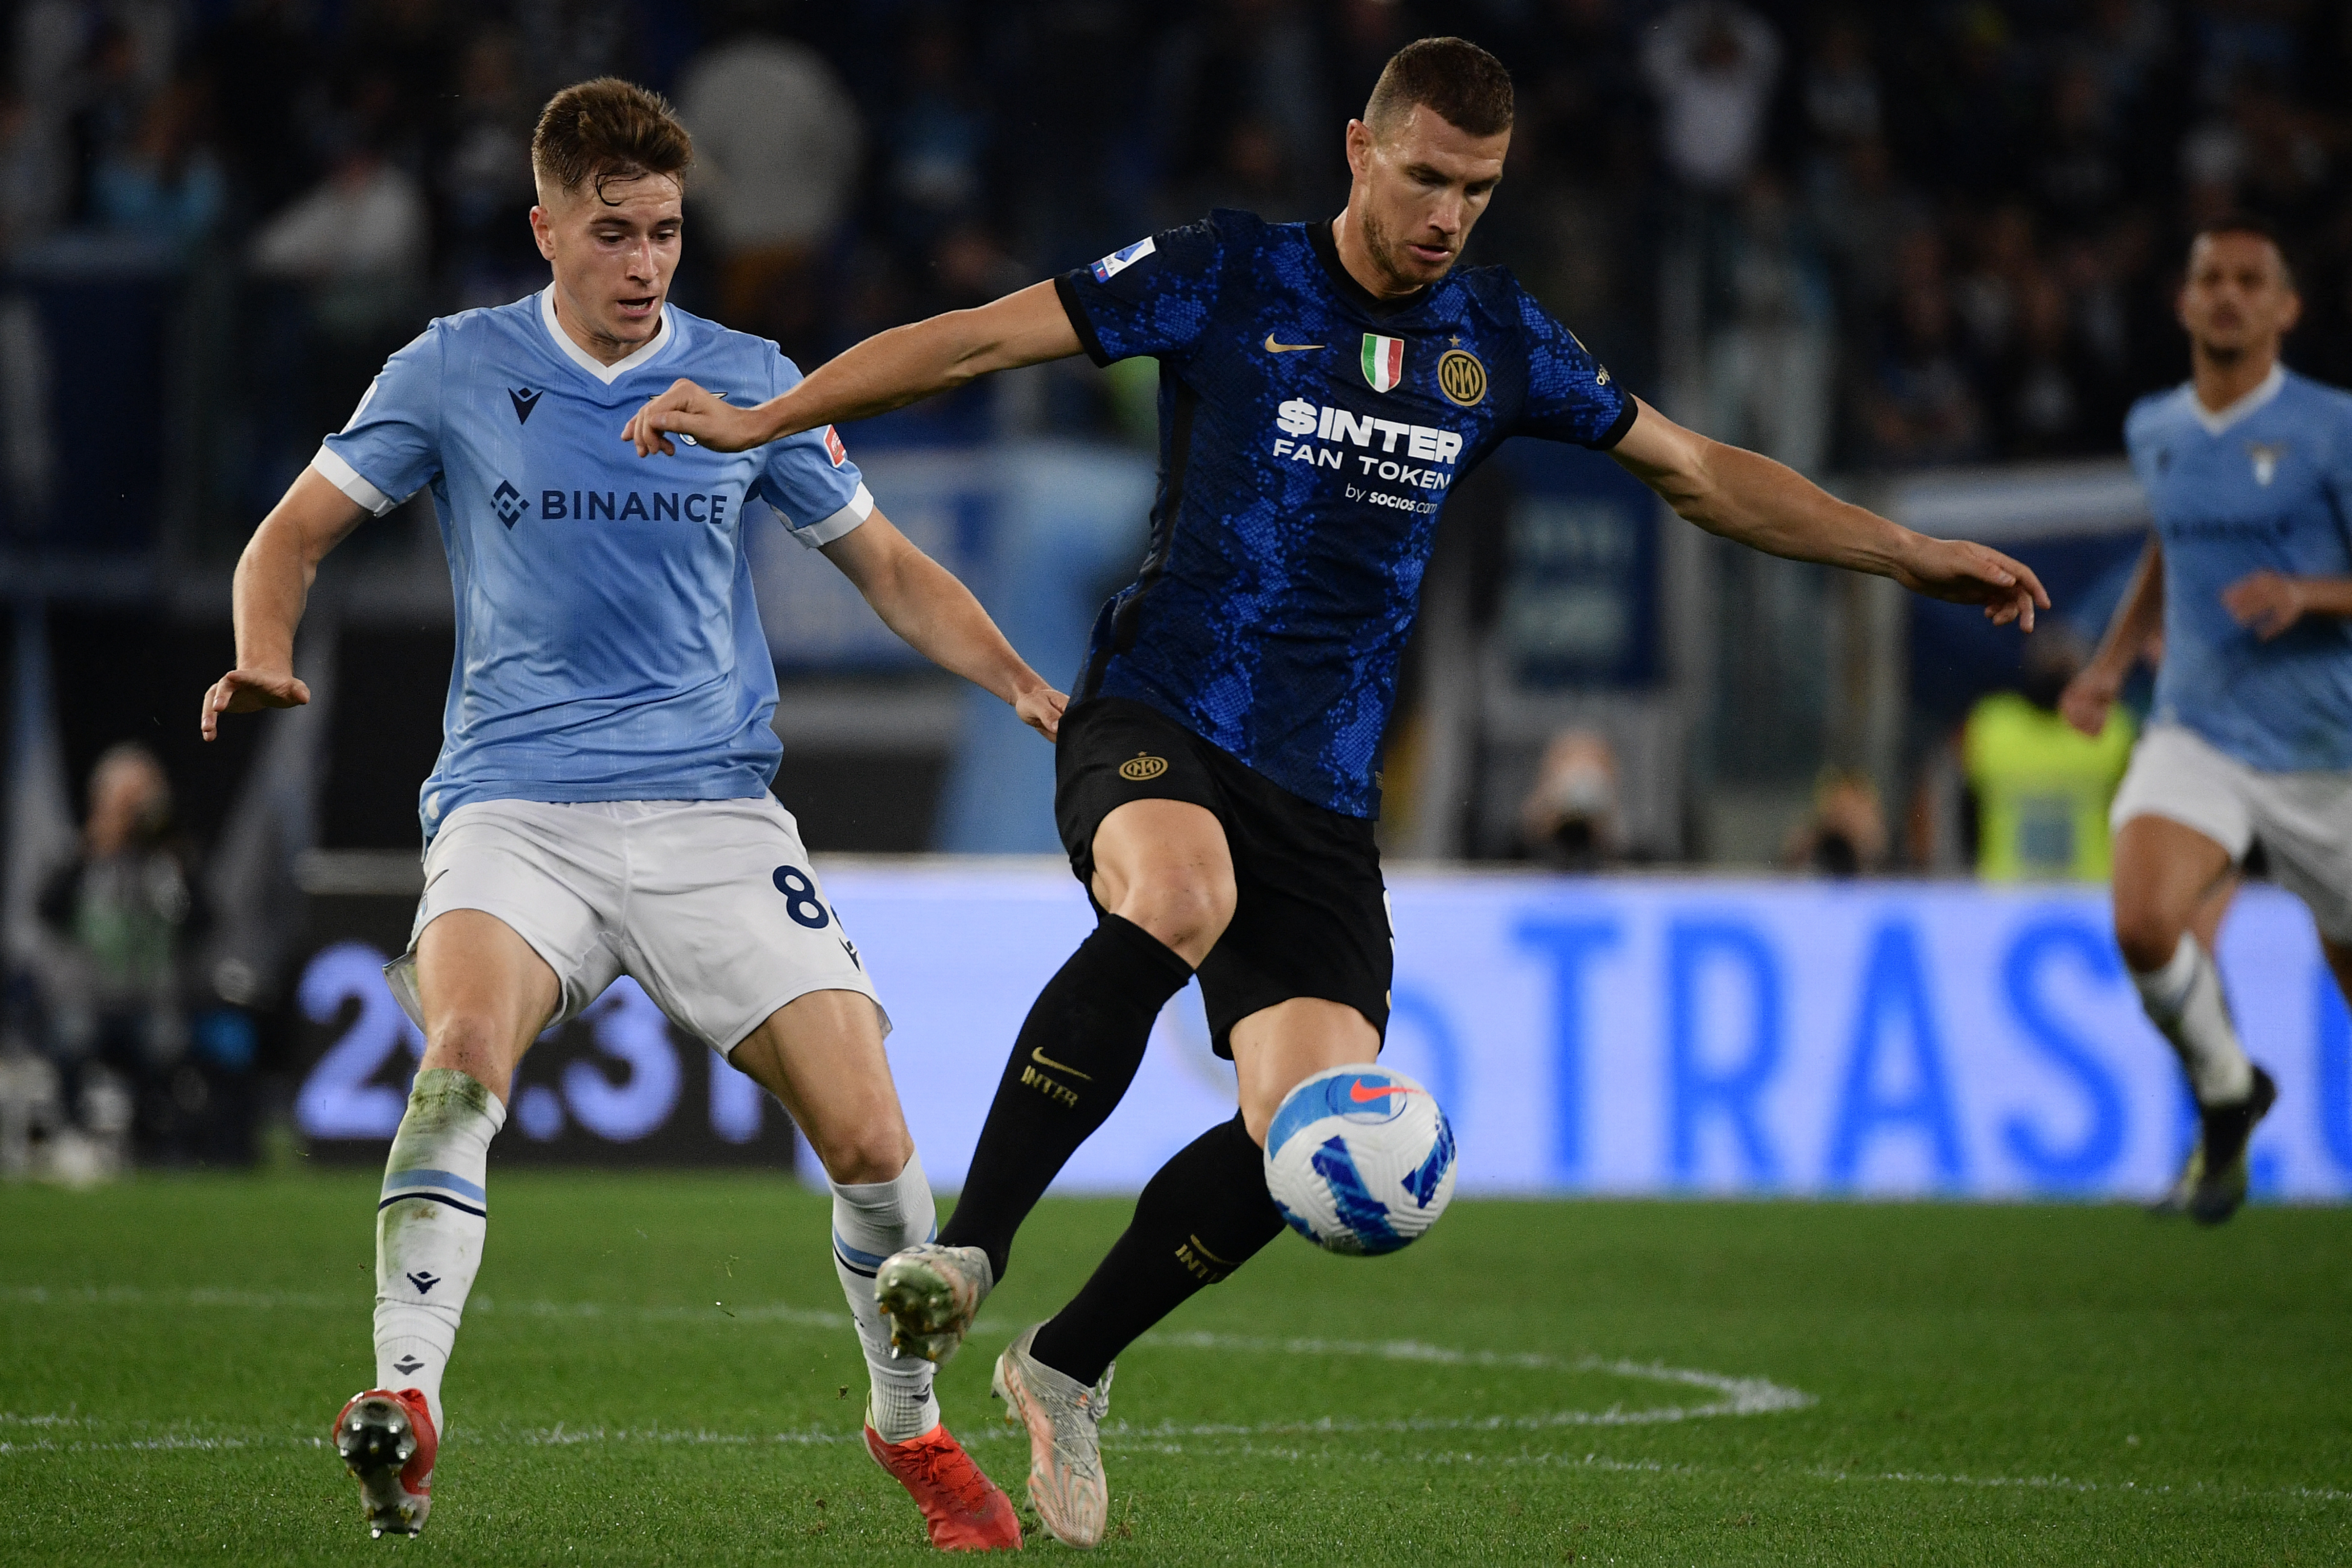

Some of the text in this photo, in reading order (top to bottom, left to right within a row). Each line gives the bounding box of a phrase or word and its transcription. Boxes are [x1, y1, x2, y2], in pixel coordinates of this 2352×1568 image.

[1276, 397, 1463, 464] $INTER
[1273, 438, 1451, 490] FAN TOKEN
[542, 489, 728, 525] BINANCE
[1345, 482, 1367, 503] by
[772, 865, 845, 933] 8
[1508, 915, 2352, 1185] TRAS
[1020, 1064, 1078, 1109] INTER
[1174, 1243, 1221, 1284] INT
